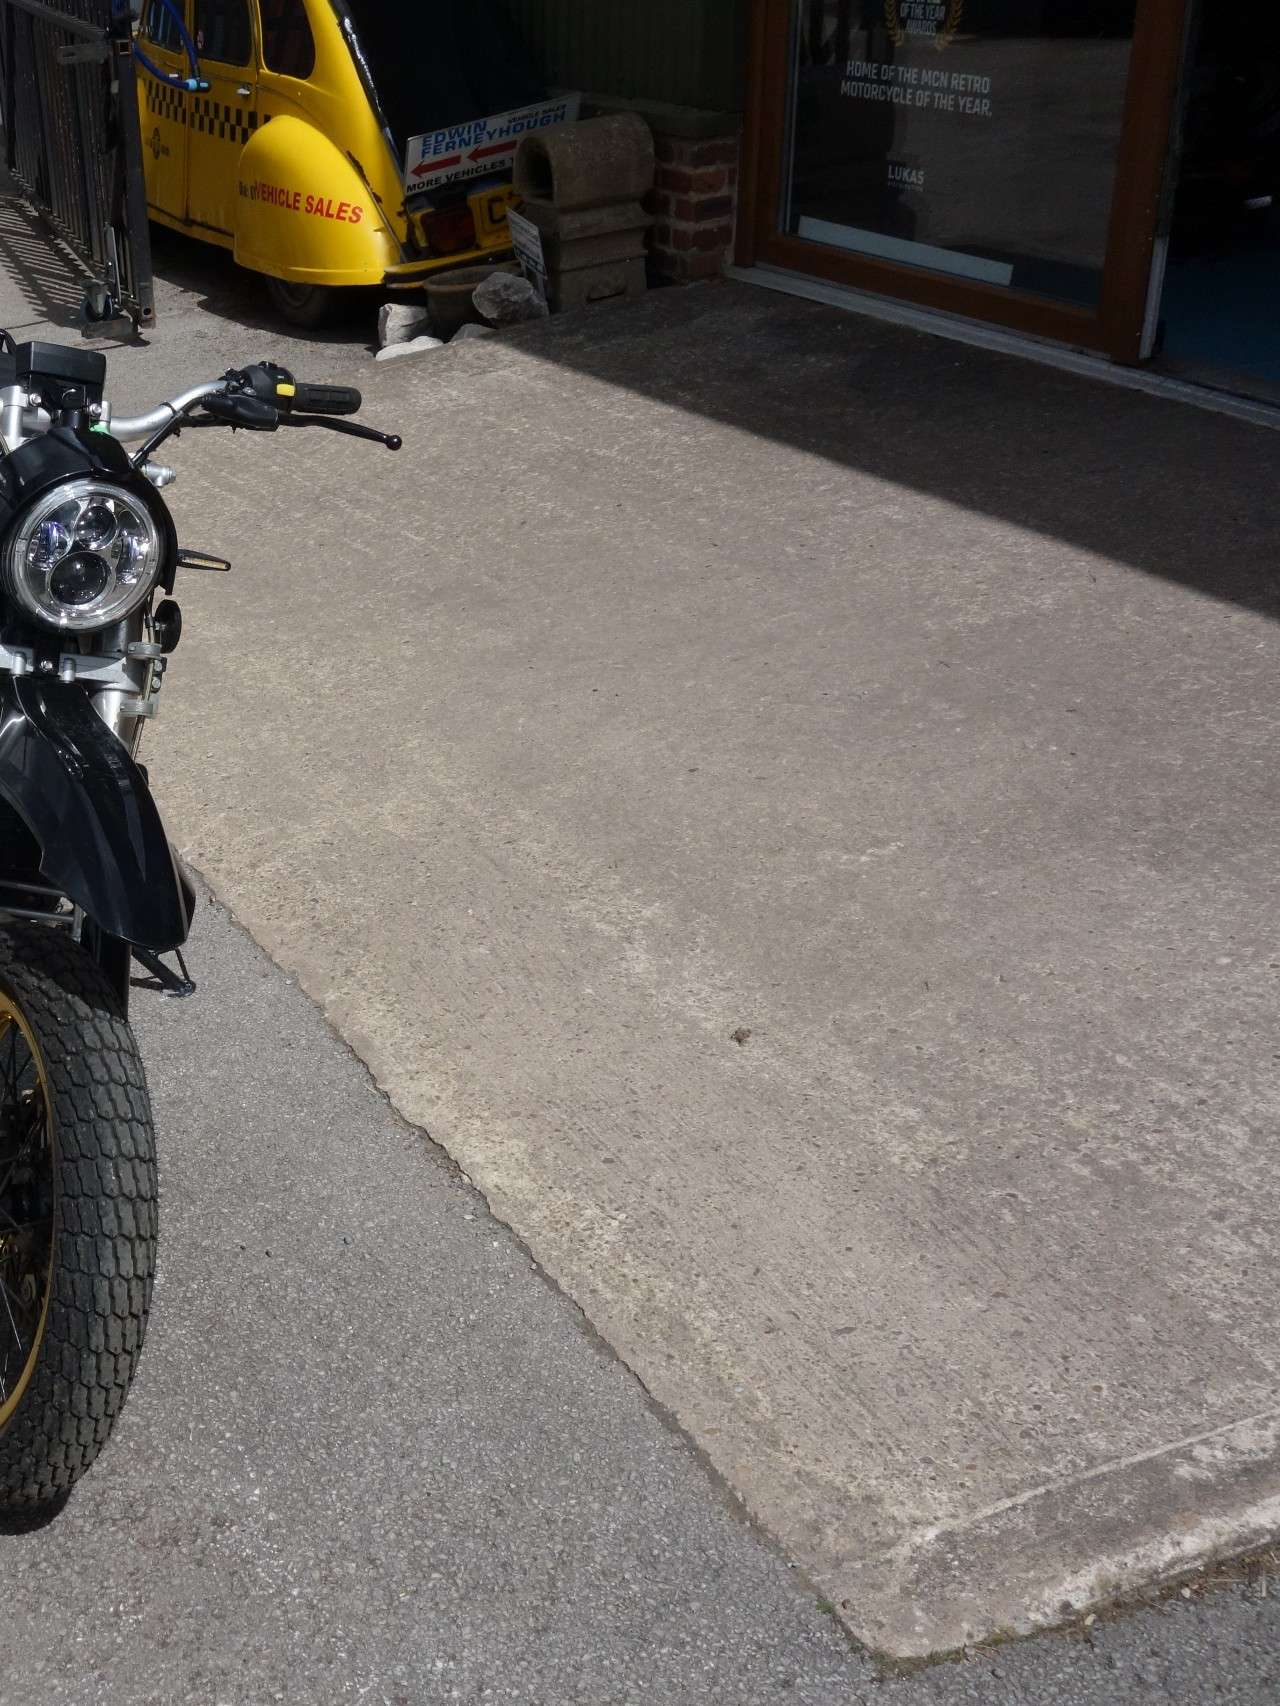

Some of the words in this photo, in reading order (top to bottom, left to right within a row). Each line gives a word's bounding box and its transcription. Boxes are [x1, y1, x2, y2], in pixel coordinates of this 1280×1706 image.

[846, 61, 879, 81] HOME
[880, 65, 894, 82] OF
[898, 67, 919, 86] THE
[920, 69, 949, 89] MCN
[951, 73, 992, 95] RETRO
[840, 81, 912, 105] MOTORCYCLE
[916, 91, 931, 108] OF
[933, 93, 955, 111] THE
[422, 120, 488, 145] EDWIN
[422, 113, 568, 158] FERNEYHOUGH
[406, 176, 442, 193] MORE
[446, 159, 505, 182] VEHICLES
[888, 164, 925, 185] LUKAS
[255, 181, 302, 212] VEHICLE
[305, 194, 363, 224] SALES
